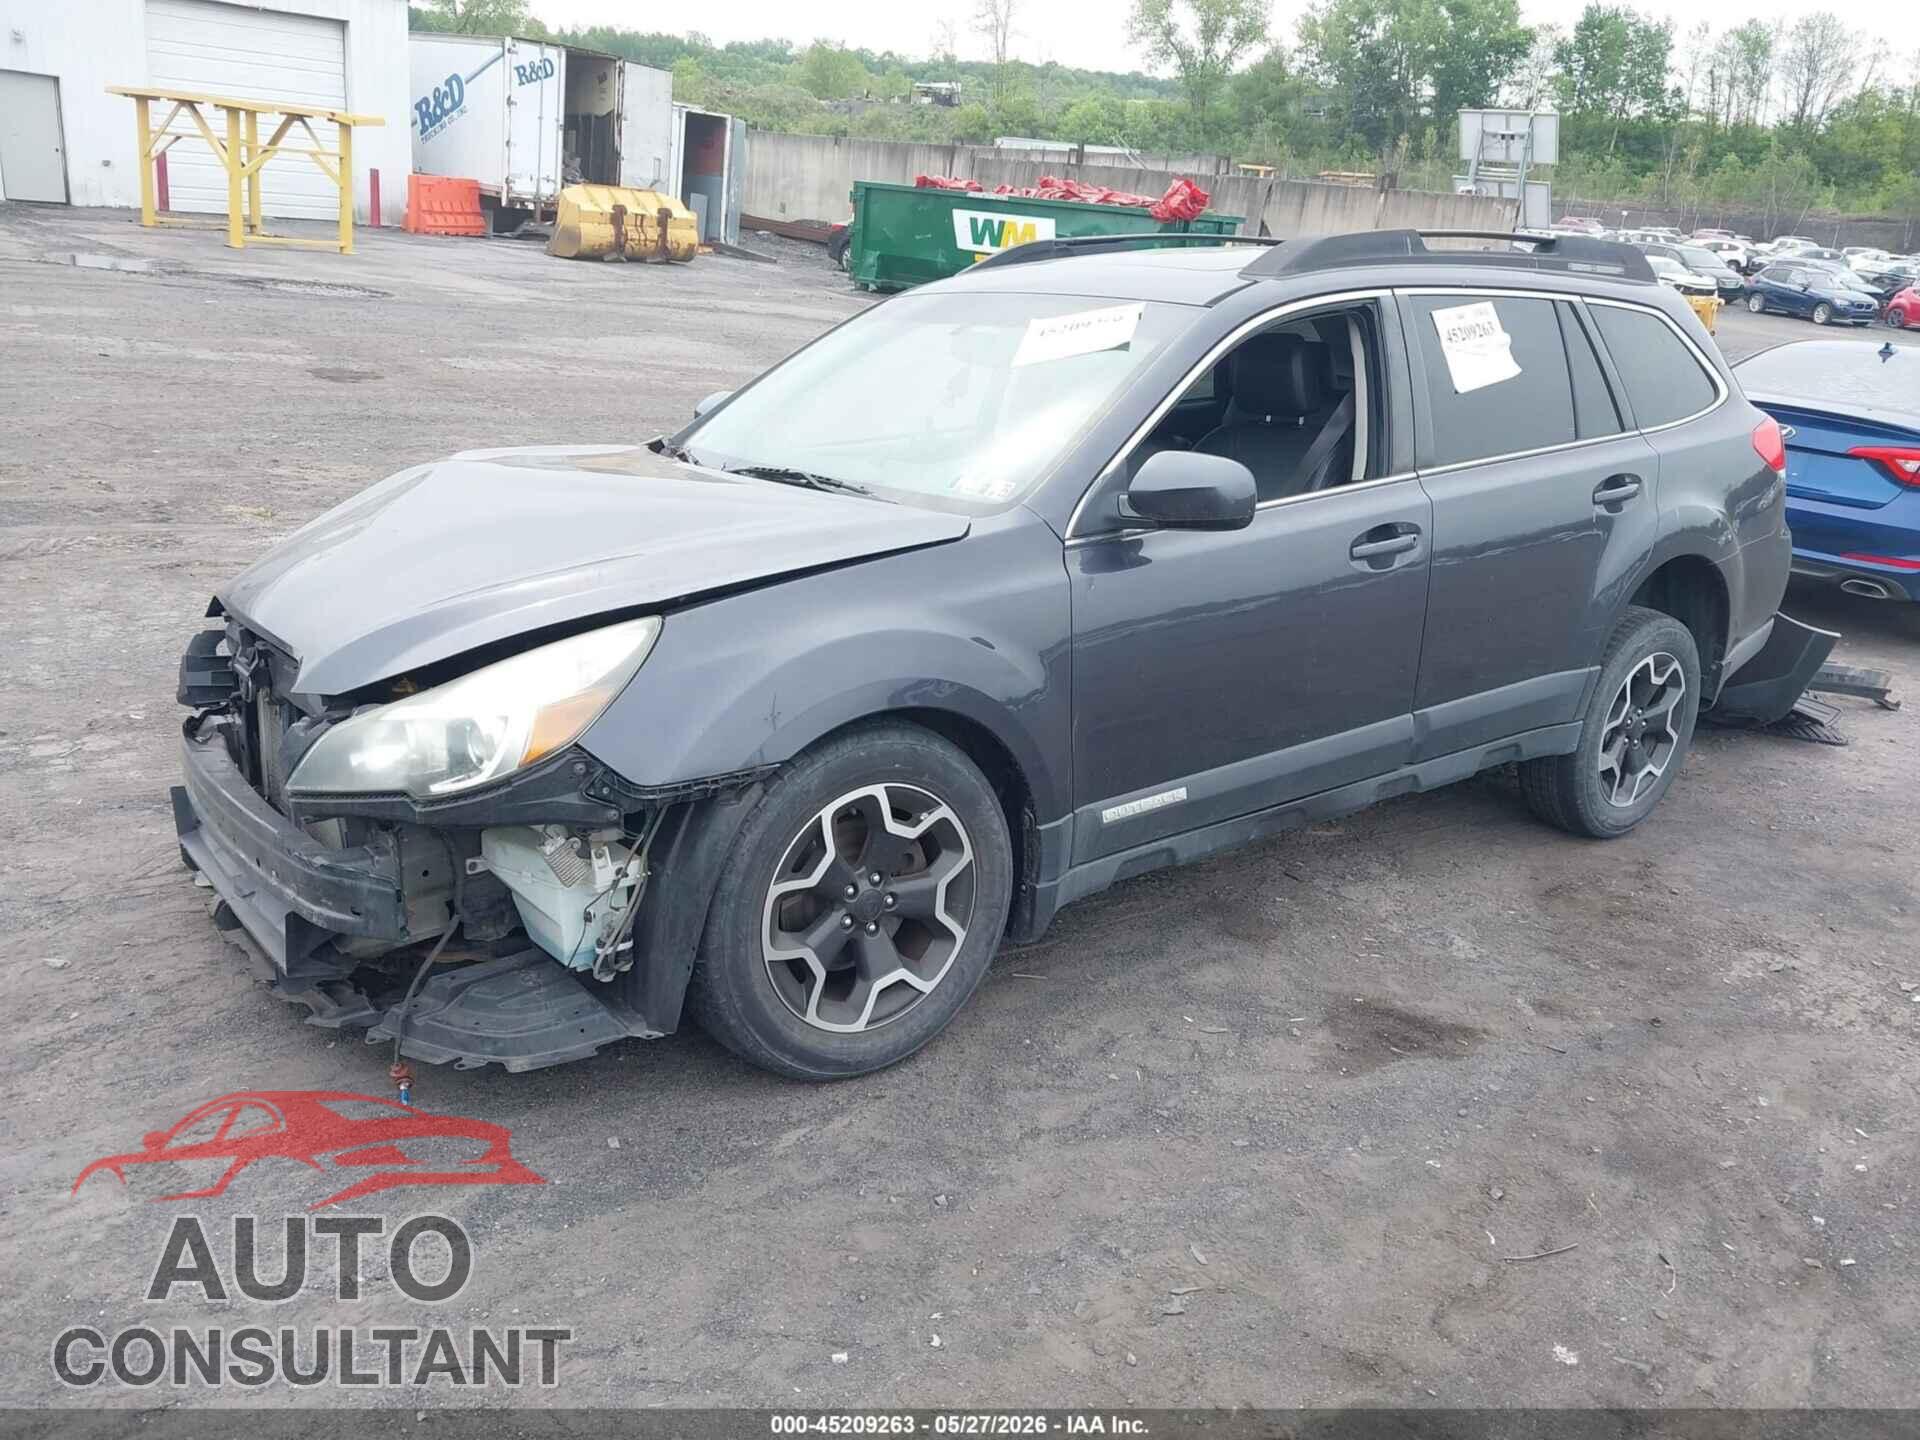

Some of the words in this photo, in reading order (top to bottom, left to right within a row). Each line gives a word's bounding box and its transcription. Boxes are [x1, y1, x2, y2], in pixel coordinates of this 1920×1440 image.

[514, 58, 554, 86] R&D
[414, 73, 465, 136] R&D
[969, 216, 1036, 249] WM
[1447, 320, 1495, 344] 45209263
